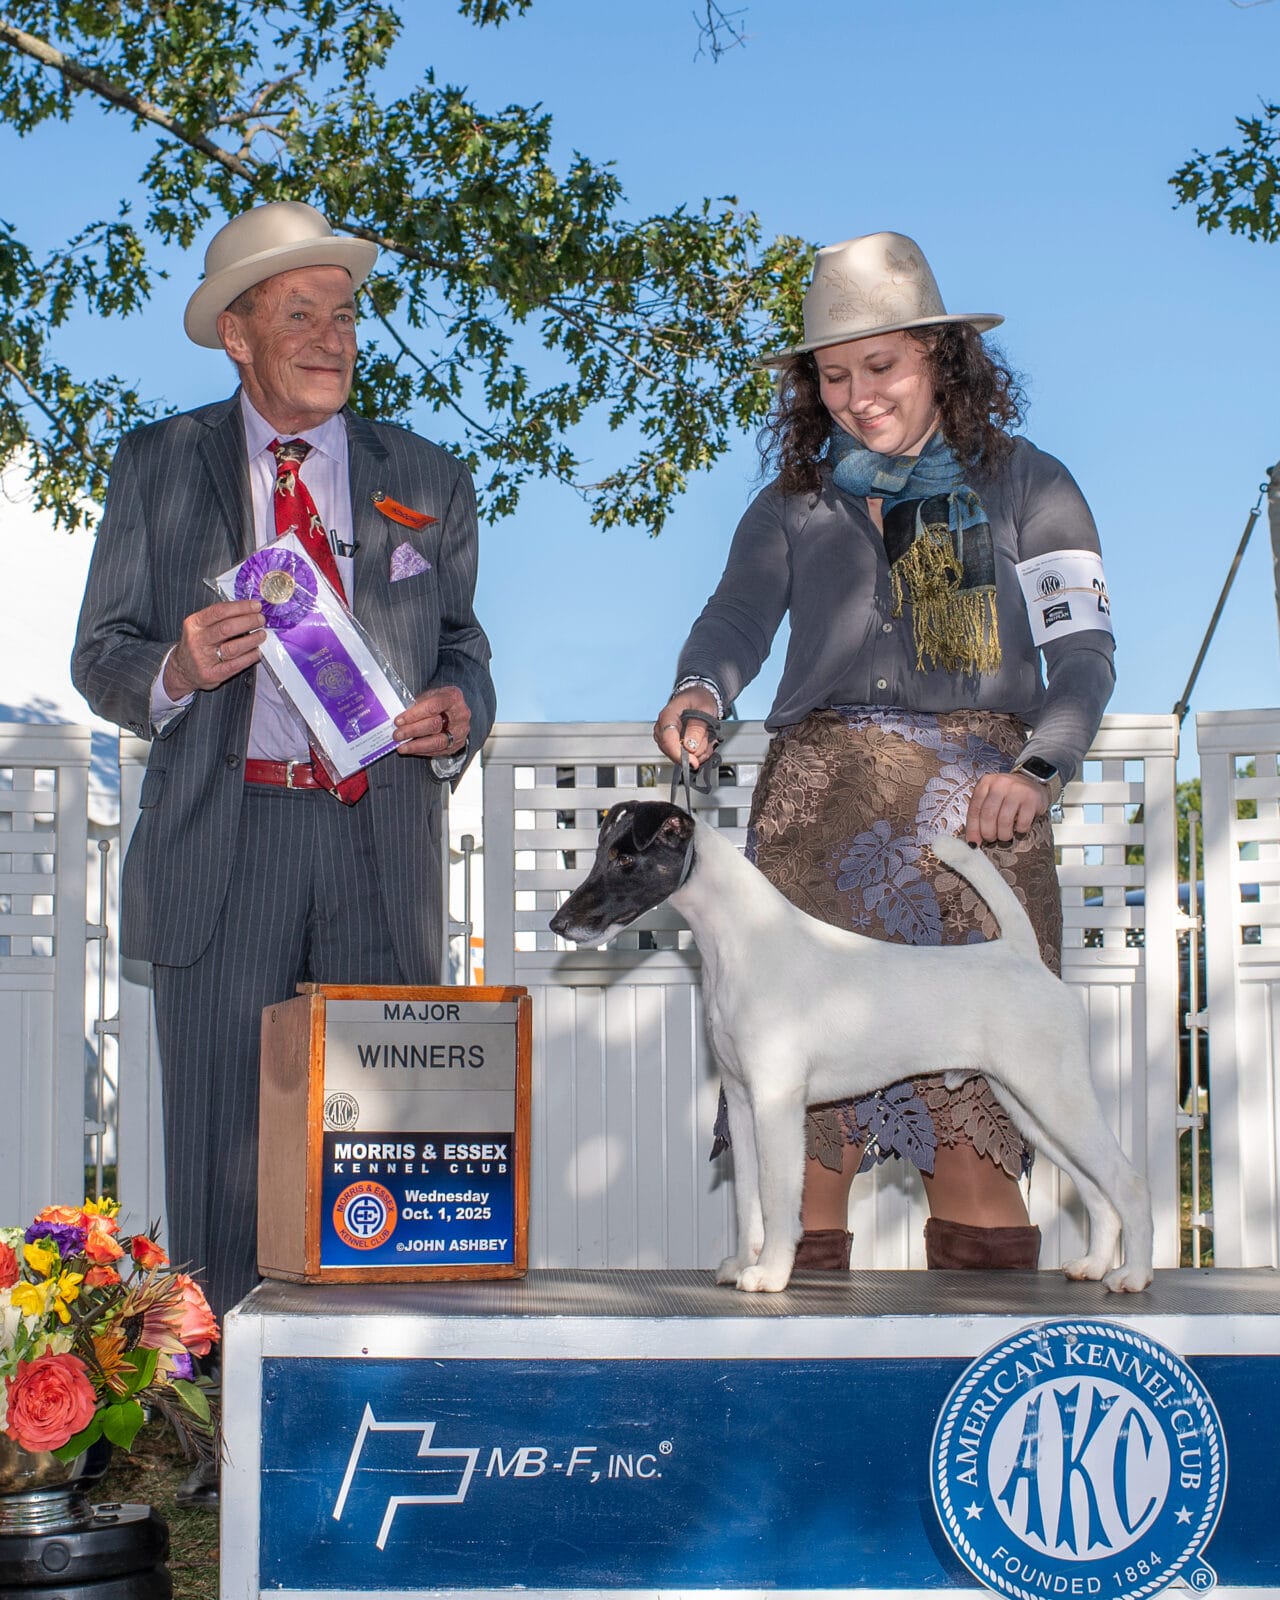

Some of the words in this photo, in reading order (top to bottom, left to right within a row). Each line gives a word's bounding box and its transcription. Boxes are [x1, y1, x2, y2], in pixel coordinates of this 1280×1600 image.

[384, 1003, 460, 1021] MAJOR
[357, 1044, 485, 1068] WINNERS
[334, 1143, 416, 1160] MORRIS
[422, 1144, 437, 1160] &
[444, 1144, 507, 1160] ESSEX
[334, 1163, 430, 1174] KENNEL
[449, 1163, 507, 1174] CLUB
[336, 1184, 364, 1213] MORRIS
[366, 1184, 372, 1192] &
[374, 1186, 395, 1213] ESSEX
[404, 1189, 490, 1205] Wednesday
[402, 1207, 433, 1220] Oct.
[438, 1207, 451, 1223] 1,
[455, 1207, 492, 1220] 2025
[340, 1229, 369, 1248] KENNEL
[370, 1229, 390, 1246] CLUB
[449, 1239, 508, 1251] ASHBEY
[955, 1346, 1056, 1488] AMERICAN
[1063, 1342, 1178, 1409] KENNEL
[1169, 1408, 1201, 1490] CLUB
[997, 1382, 1157, 1556] AKC
[991, 1545, 1102, 1595] FOUNDED
[1112, 1551, 1163, 1588] 1884
